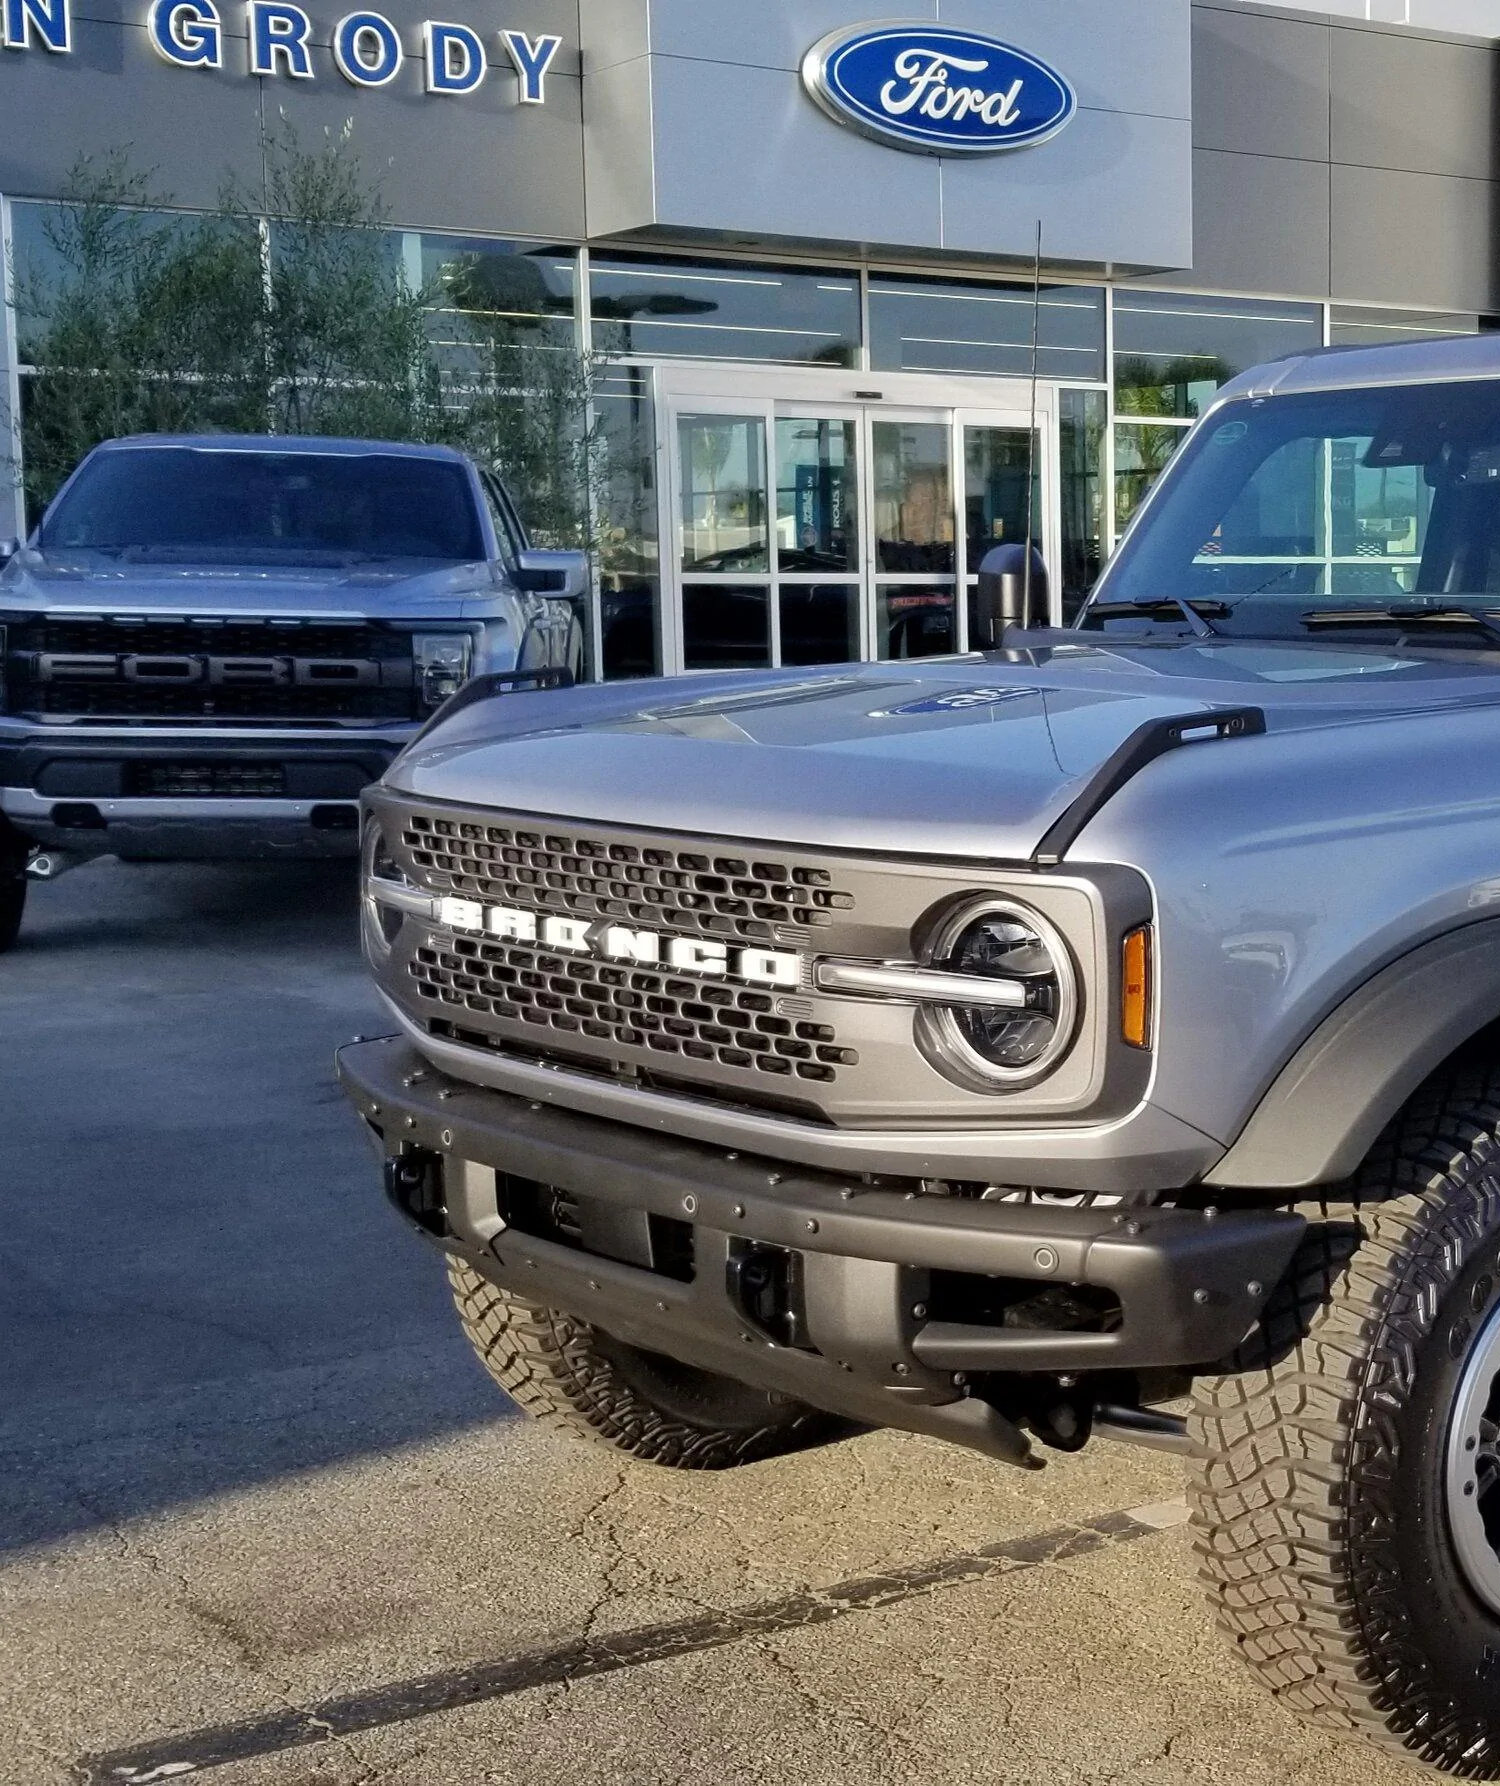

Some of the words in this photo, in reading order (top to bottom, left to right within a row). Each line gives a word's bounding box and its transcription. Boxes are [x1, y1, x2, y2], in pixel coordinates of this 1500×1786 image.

[147, 0, 563, 104] GRODY
[880, 48, 1024, 127] Ford
[40, 653, 383, 687] FORD
[440, 896, 802, 987] BRONCO
